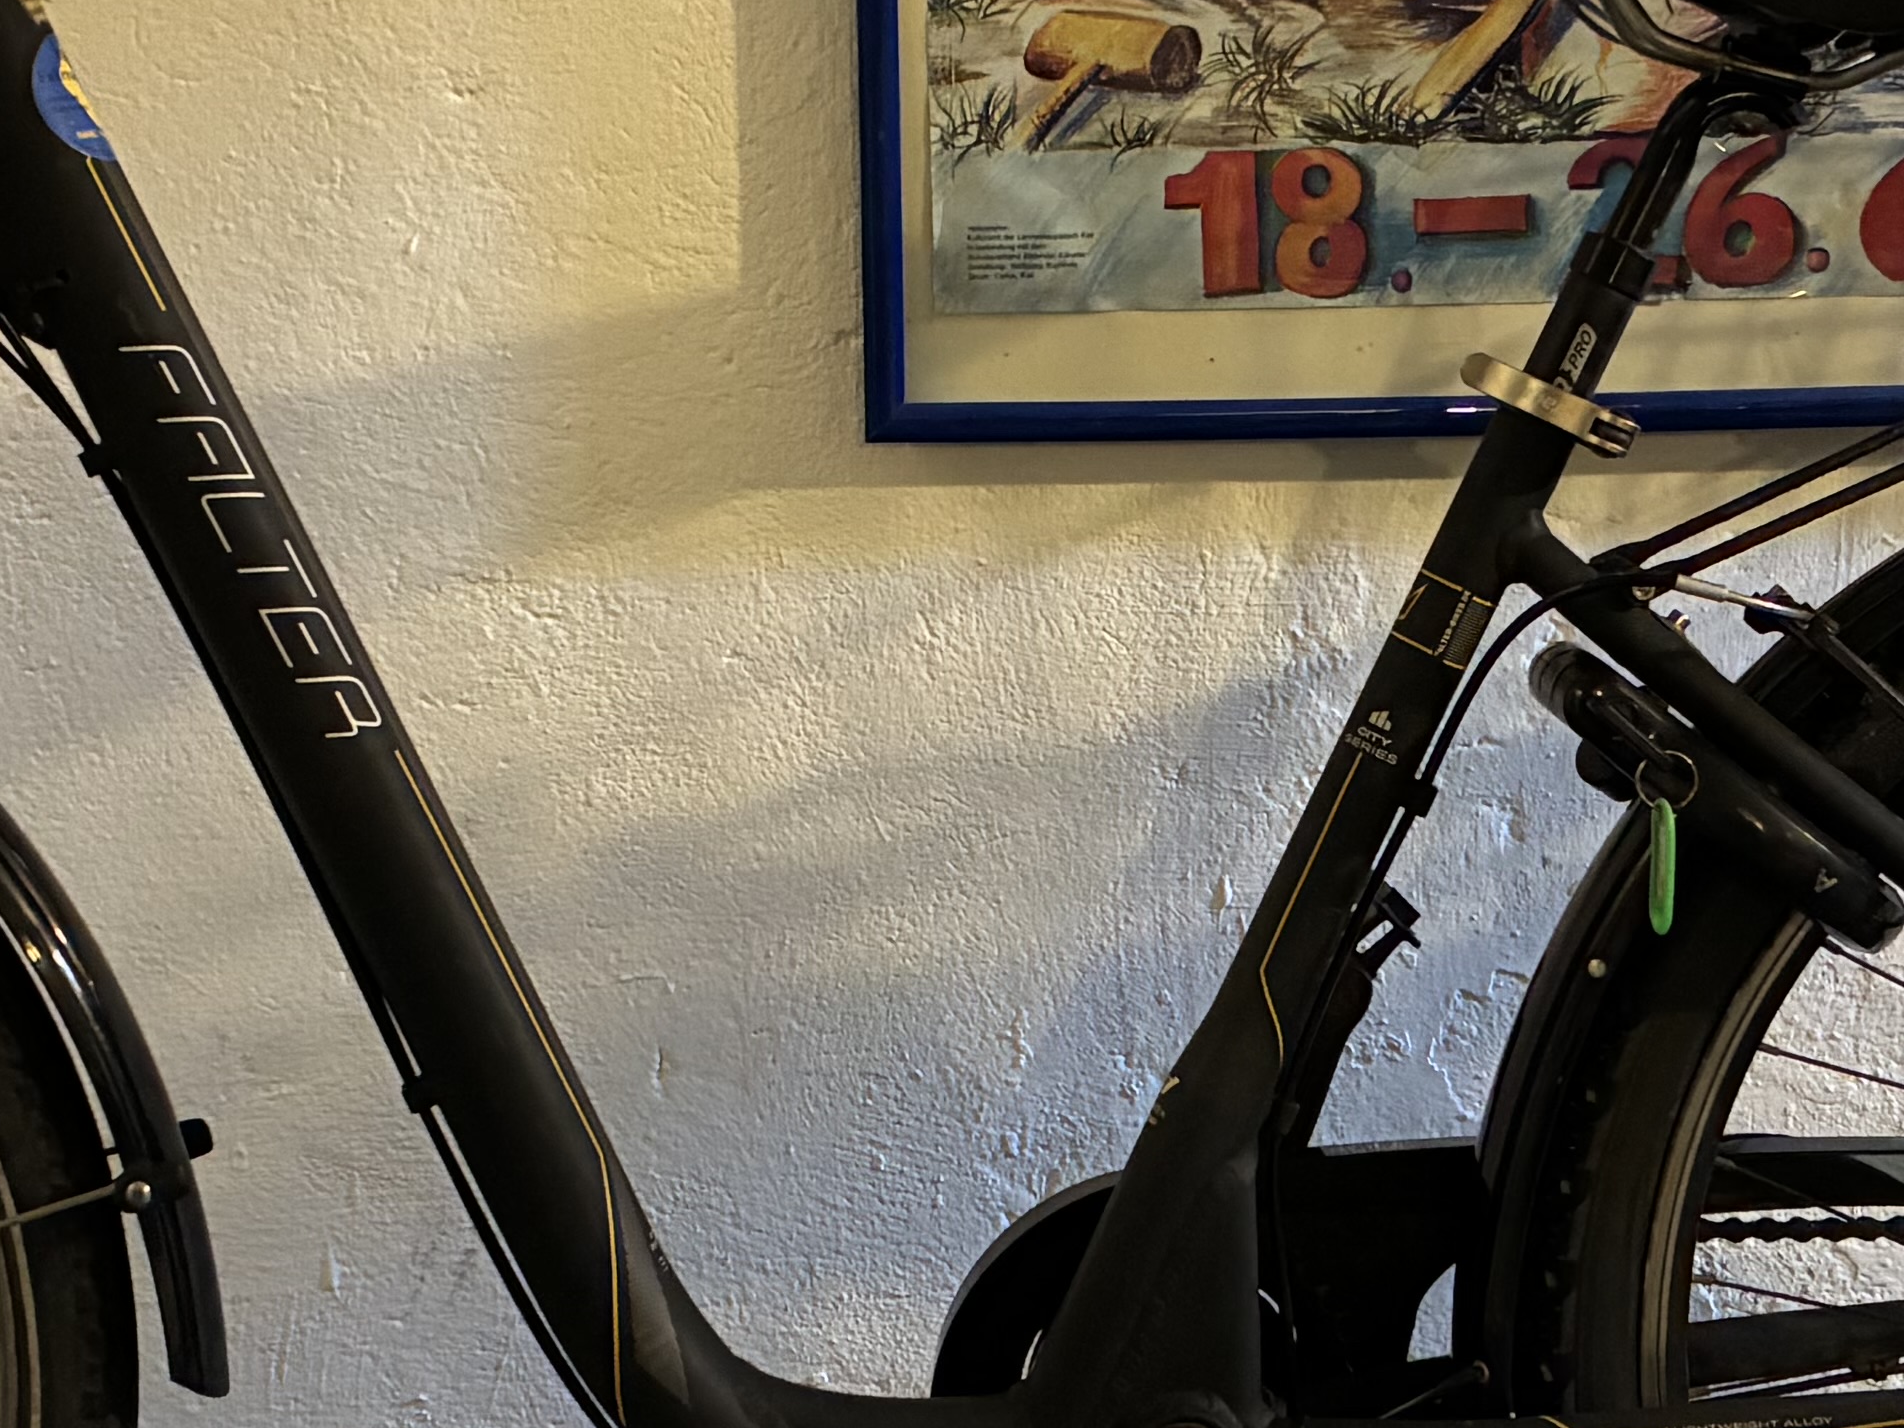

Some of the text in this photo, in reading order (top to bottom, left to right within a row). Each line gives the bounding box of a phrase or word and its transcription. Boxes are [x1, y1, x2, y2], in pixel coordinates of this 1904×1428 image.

[1569, 330, 1592, 369] PRO
[119, 344, 383, 740] FALTER
[1344, 733, 1398, 765] SERIES
[1357, 726, 1393, 747] CITY
[1783, 1416, 1833, 1427] ALLOY
